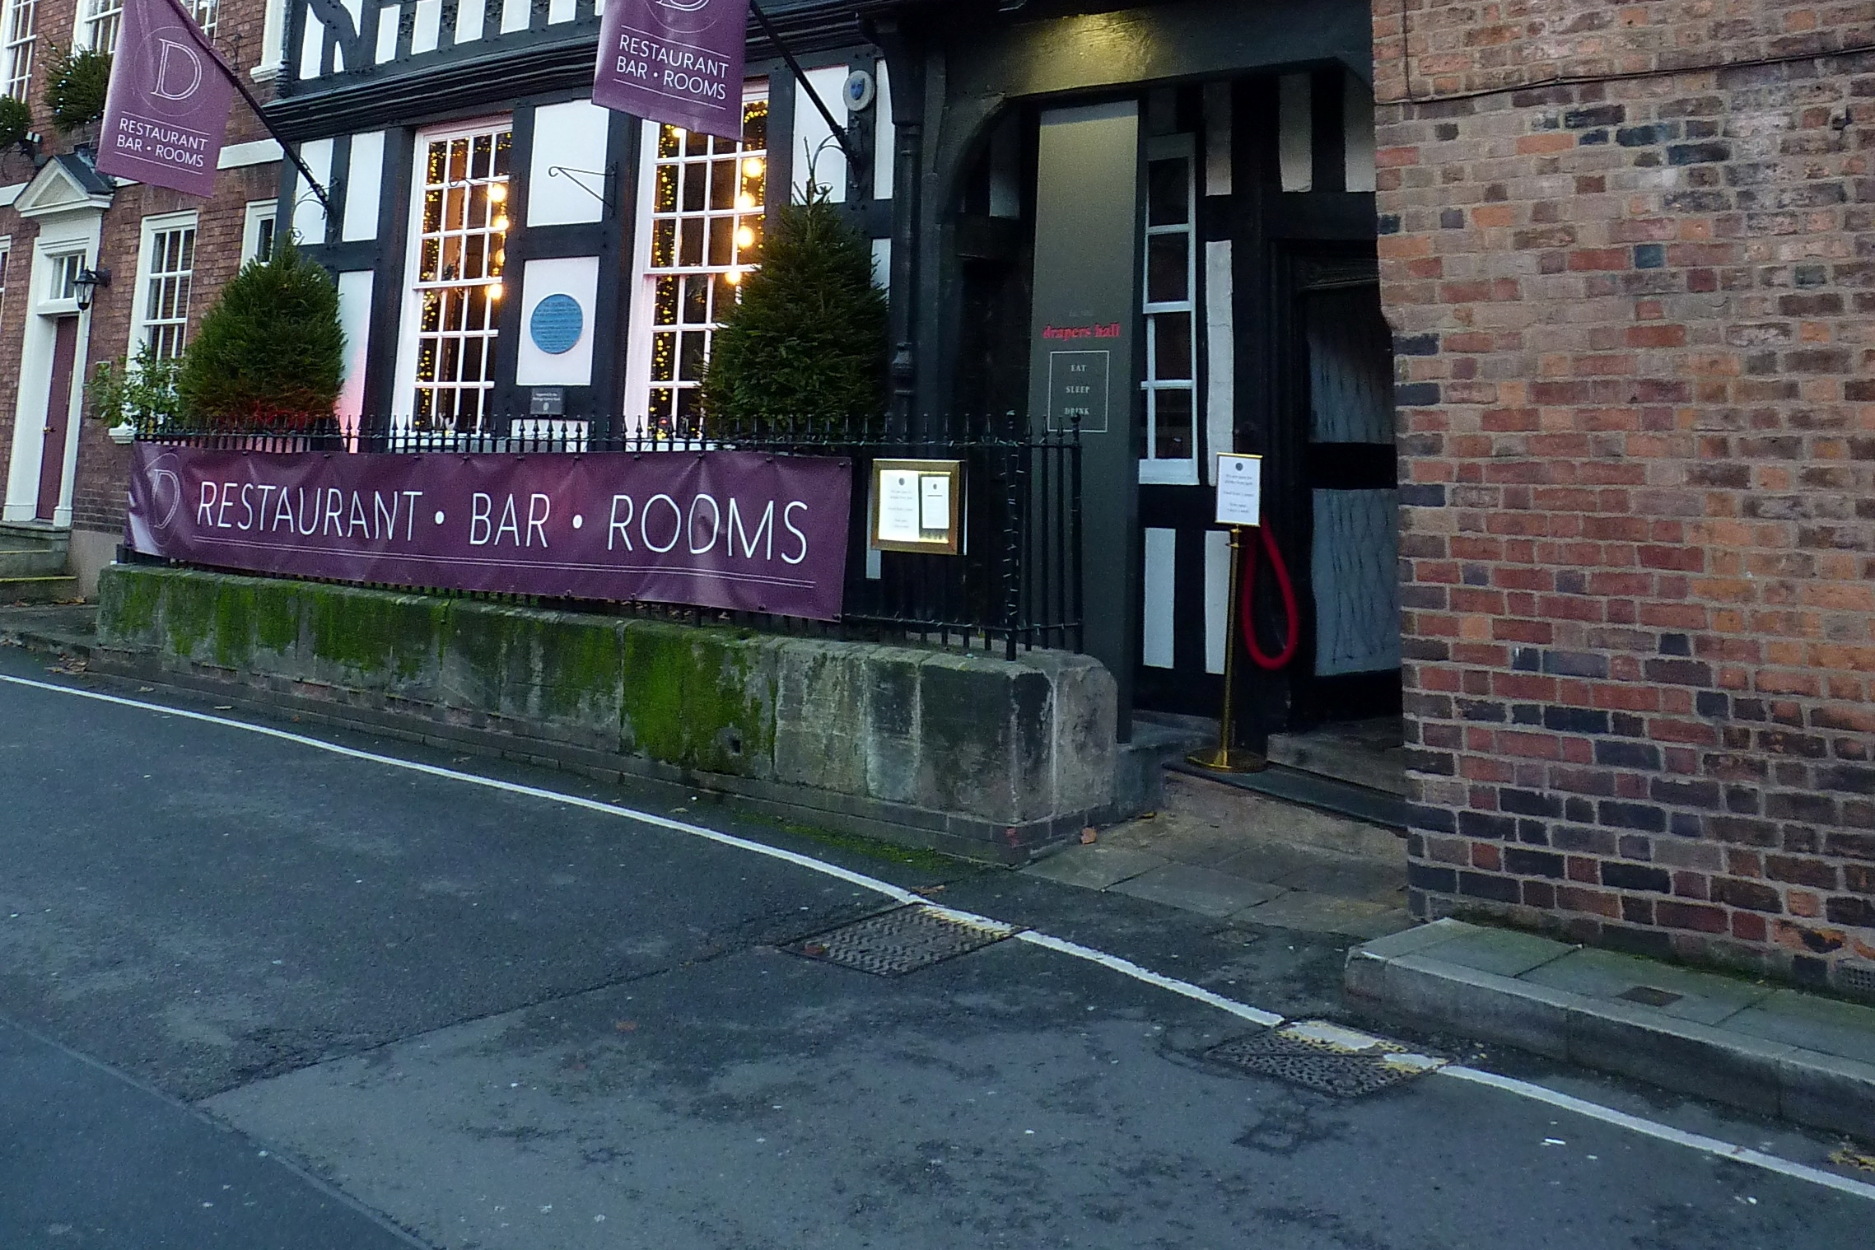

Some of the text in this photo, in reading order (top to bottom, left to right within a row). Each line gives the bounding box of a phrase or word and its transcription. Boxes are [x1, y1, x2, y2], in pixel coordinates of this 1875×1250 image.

[150, 38, 202, 100] D
[619, 34, 729, 79] RESTAURANT
[616, 56, 726, 100] BAR ROOMS
[117, 134, 204, 167] BAR ROOMS
[119, 118, 208, 151] RESTAURANT
[1042, 322, 1121, 341] drapers hall
[1070, 364, 1087, 372] EAT
[1065, 386, 1090, 394] SLEEP
[197, 481, 808, 565] RESTAURANT BAR ROOMS
